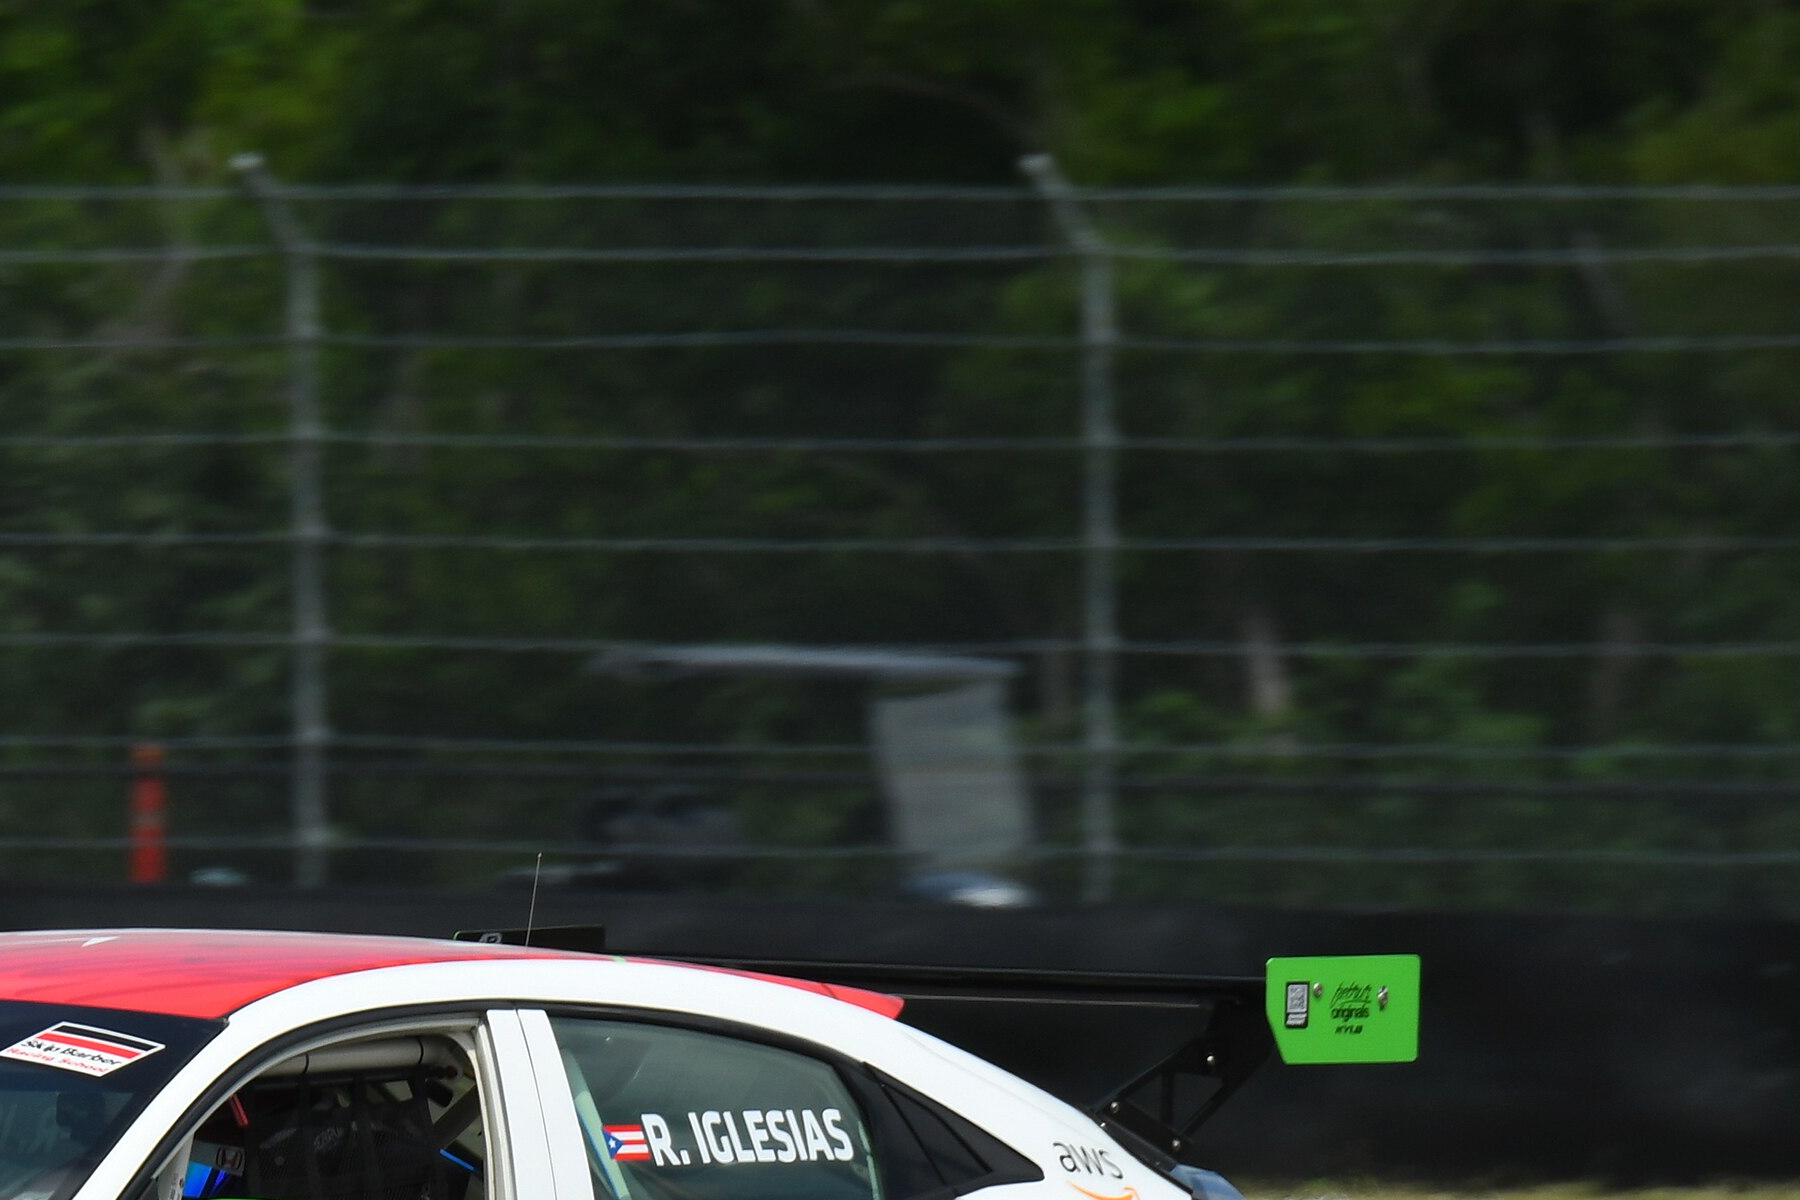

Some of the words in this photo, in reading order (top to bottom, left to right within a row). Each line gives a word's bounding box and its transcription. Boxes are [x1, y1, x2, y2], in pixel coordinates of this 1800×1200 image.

[641, 1113, 691, 1166] R.
[687, 1108, 855, 1164] IGLESIAS
[1053, 1142, 1124, 1180] aws
